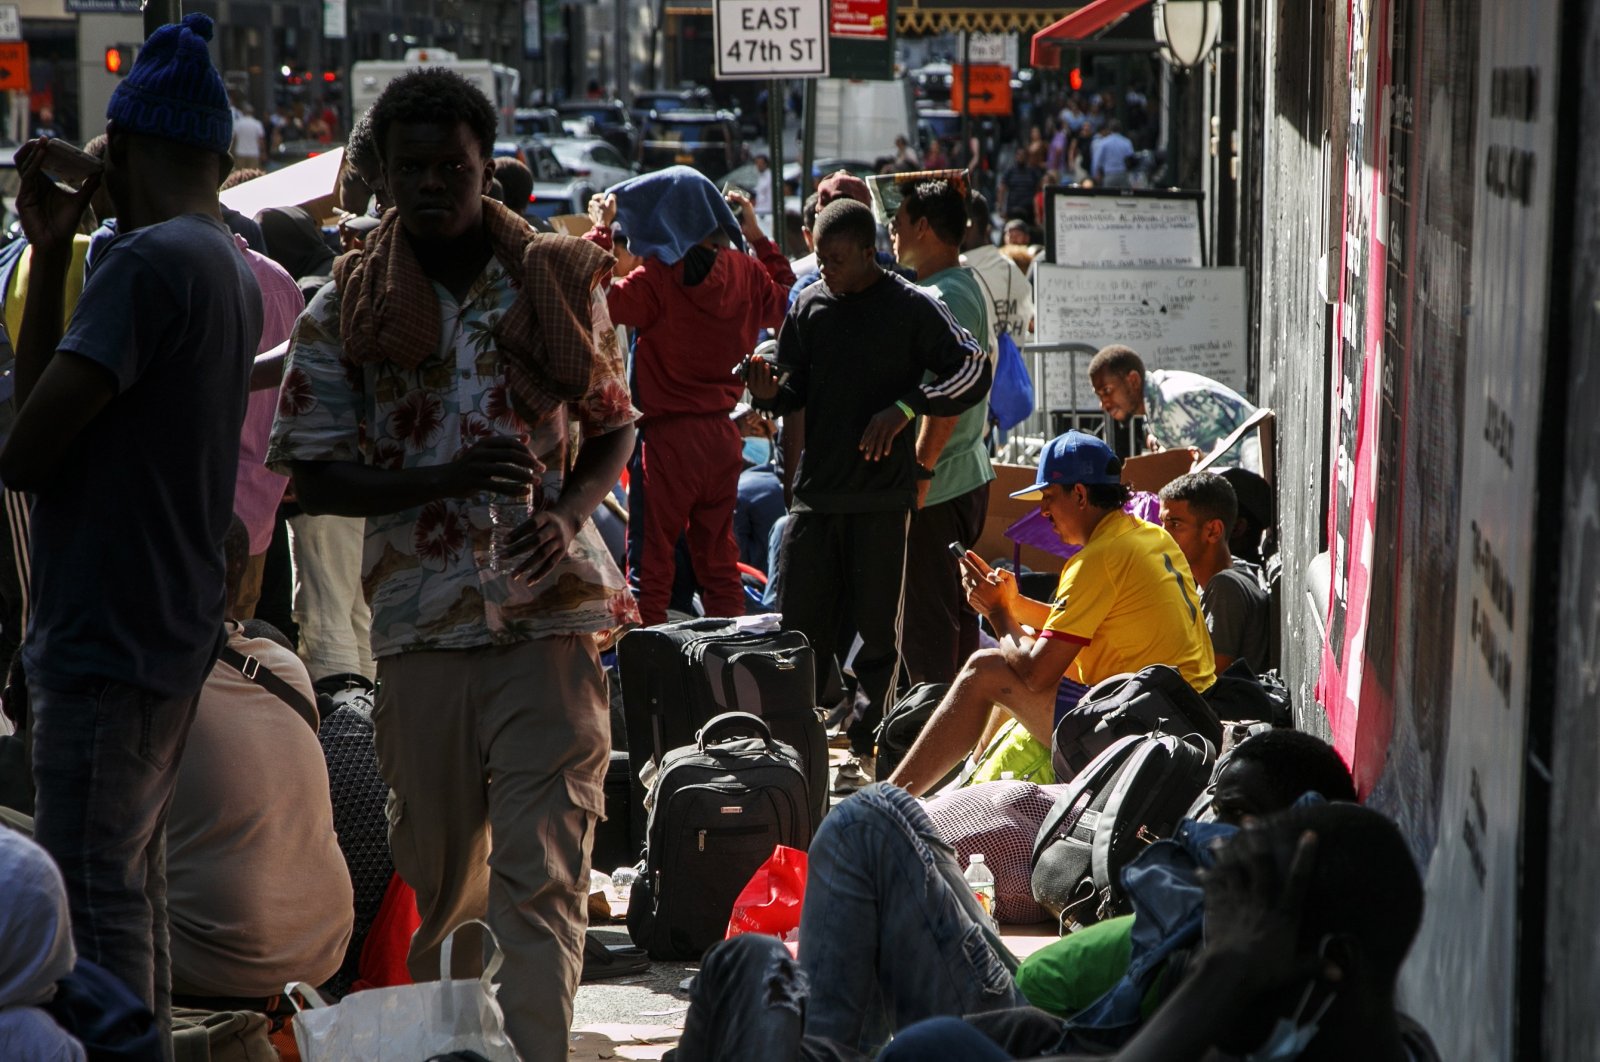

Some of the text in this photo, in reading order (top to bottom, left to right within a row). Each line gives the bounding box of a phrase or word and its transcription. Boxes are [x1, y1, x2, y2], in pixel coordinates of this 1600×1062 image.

[742, 8, 801, 30] EAST
[727, 38, 817, 62] 47th ST
